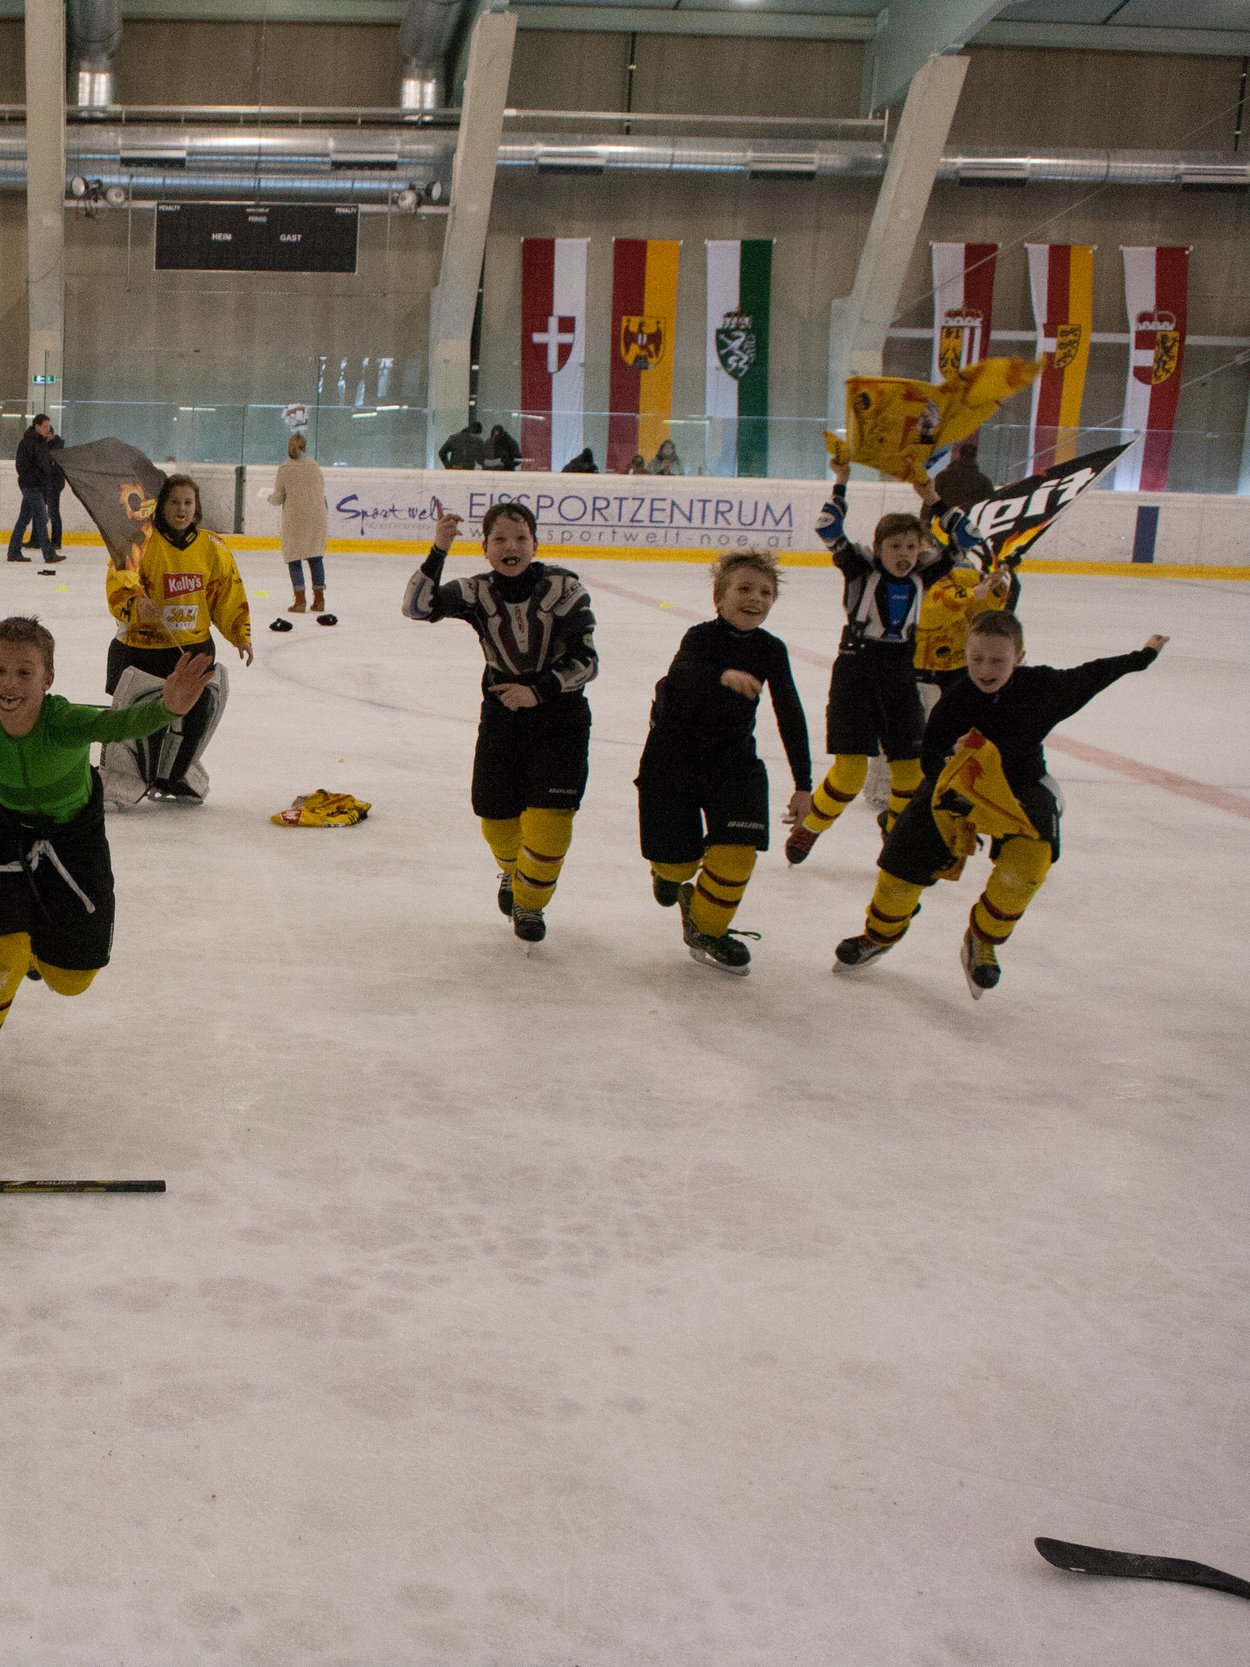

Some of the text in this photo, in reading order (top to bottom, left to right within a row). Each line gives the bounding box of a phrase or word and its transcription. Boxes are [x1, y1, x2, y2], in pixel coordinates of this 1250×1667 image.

[211, 232, 232, 242] HEIM
[279, 233, 302, 242] GAST
[168, 574, 202, 593] Kelly's
